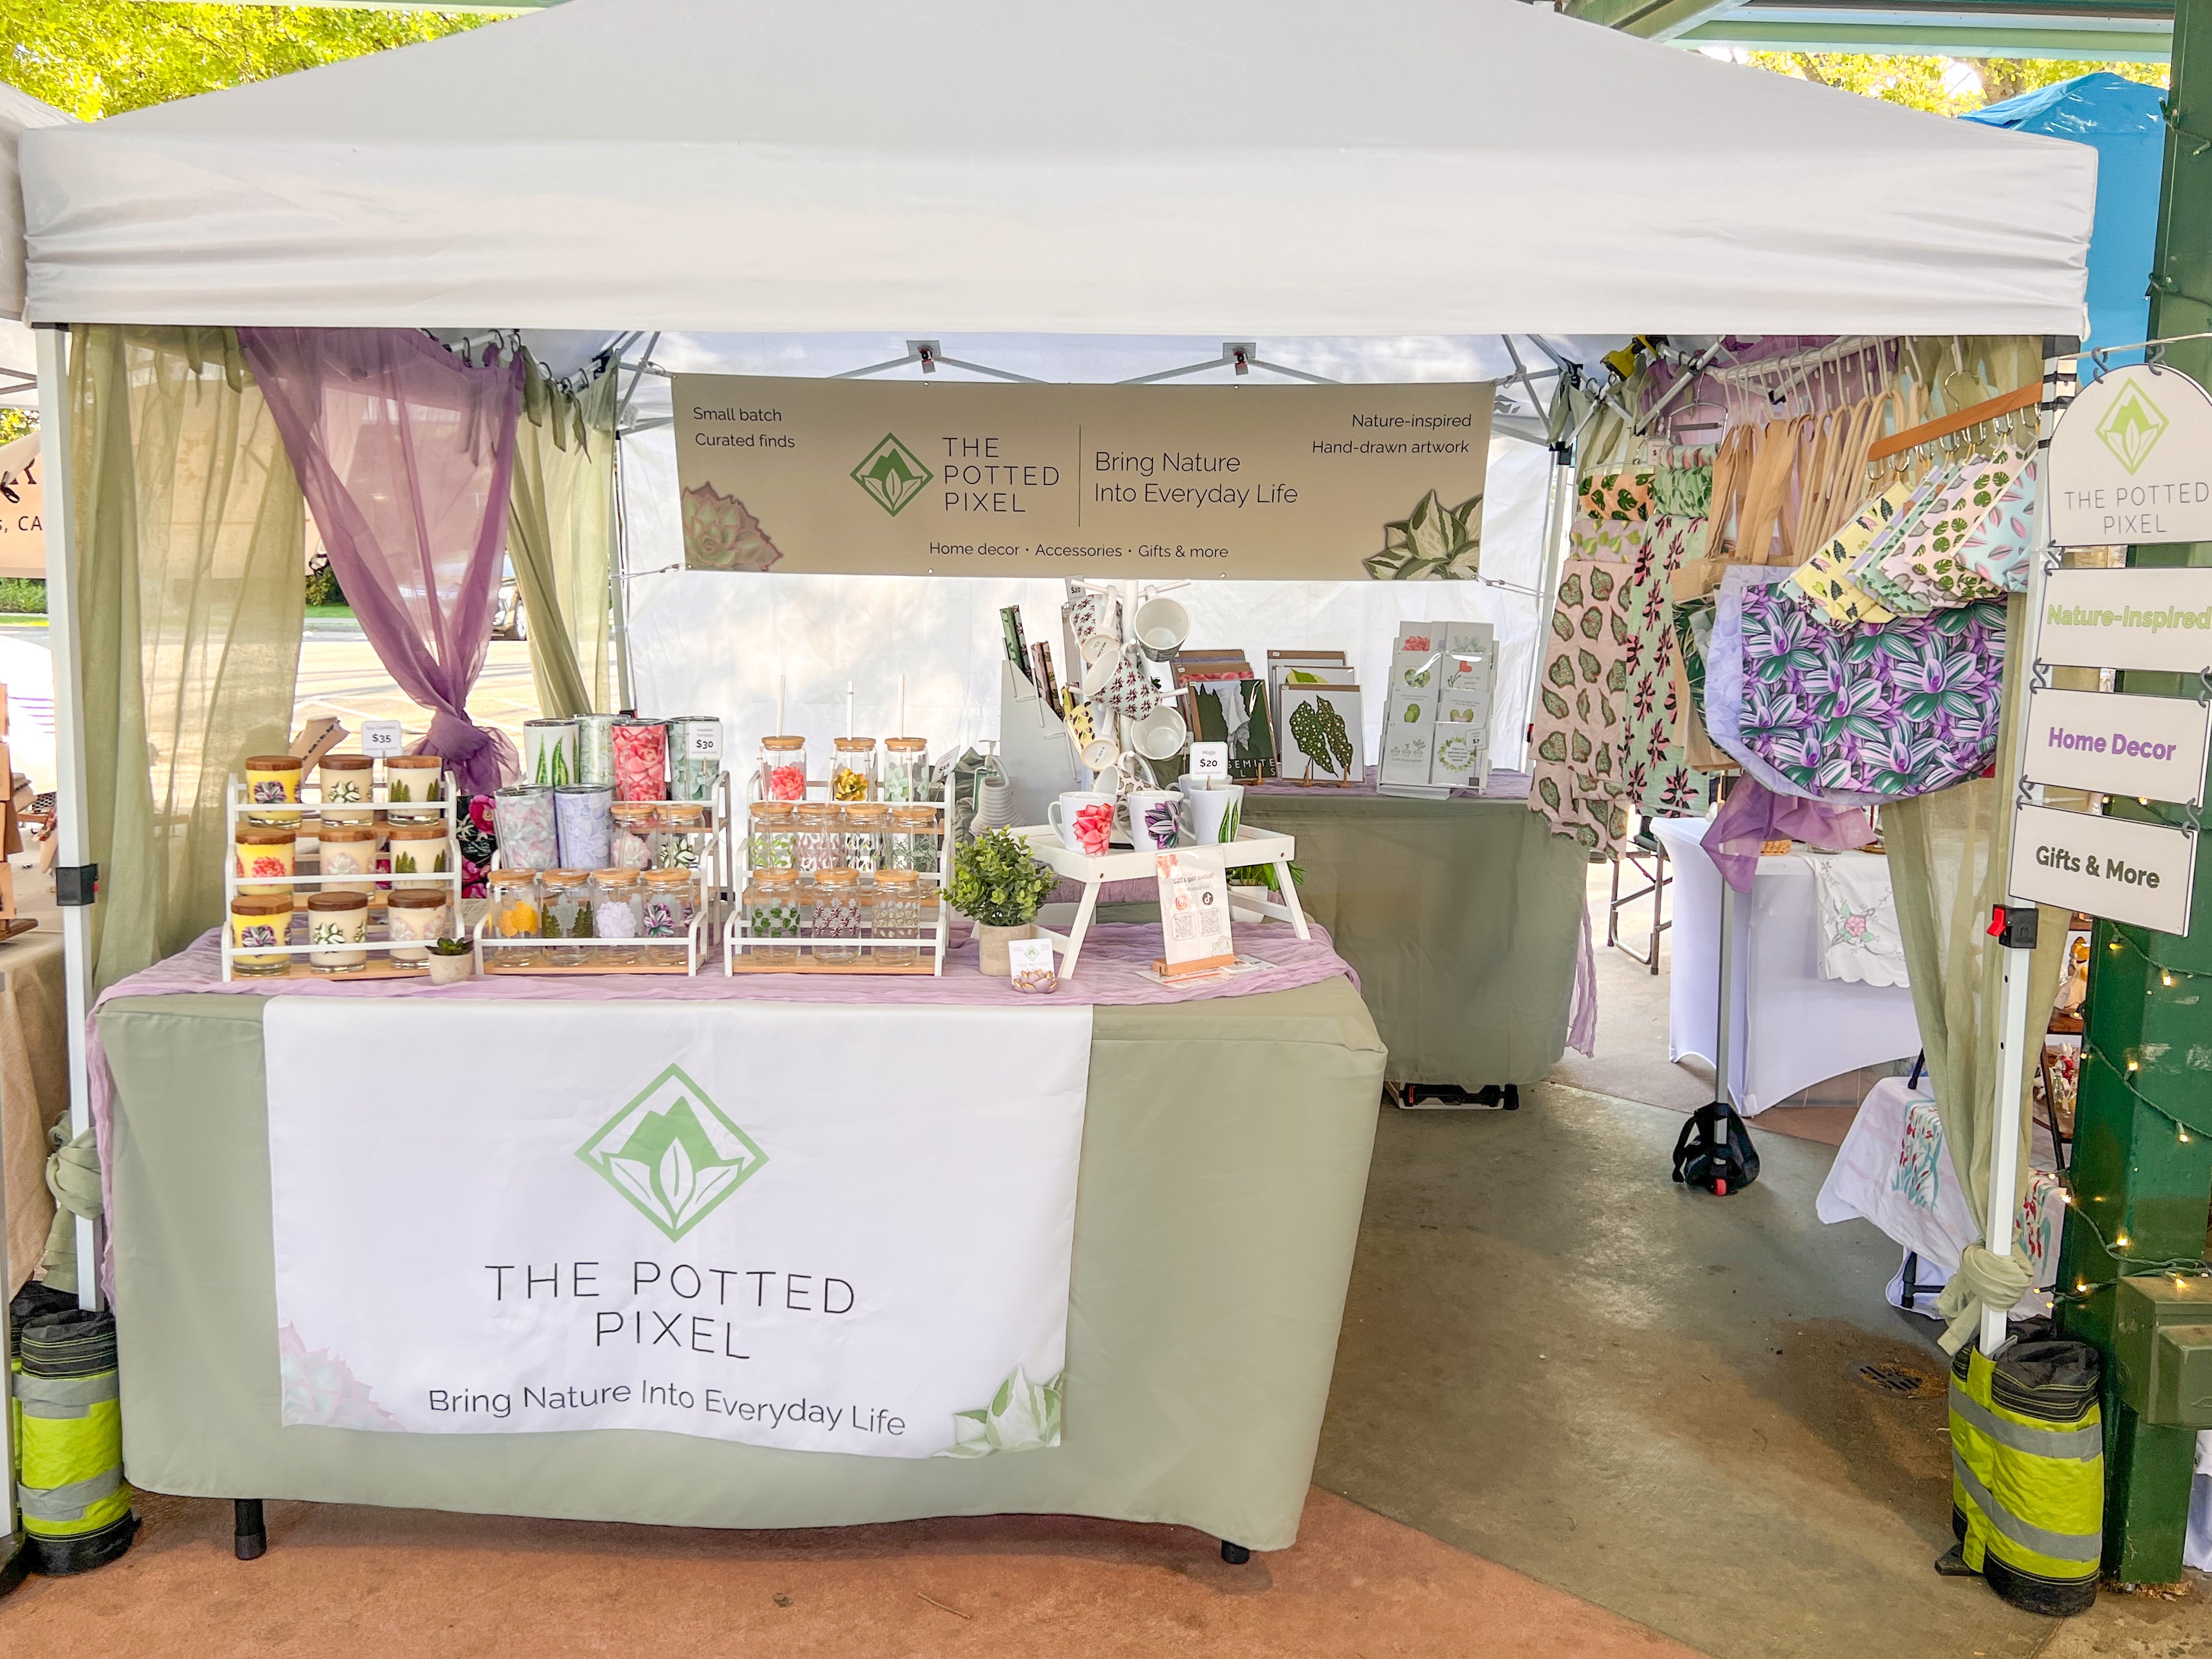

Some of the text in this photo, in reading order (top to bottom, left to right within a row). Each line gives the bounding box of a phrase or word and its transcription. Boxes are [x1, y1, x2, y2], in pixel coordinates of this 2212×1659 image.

[693, 407, 782, 422] Small batch
[1352, 414, 1471, 430] Nature-inspired
[696, 433, 795, 448] Curated finds
[942, 437, 998, 458] THE
[1313, 440, 1469, 453] Hand-drawn artwork
[1097, 451, 1241, 476] Bring Nature
[945, 465, 1059, 486] POTTED
[945, 492, 1025, 512] PIXEL
[1096, 483, 1298, 508] Into Everyday Life
[2065, 483, 2208, 509] THE POTTED
[2104, 514, 2166, 534] PIXEL
[930, 542, 1228, 558] Home decor Accessories Gifts & more
[2048, 604, 2211, 633] Nature-Inspired
[372, 734, 392, 743] $35
[696, 740, 713, 749] $30
[2049, 727, 2176, 760] Home Decor
[1200, 758, 1218, 768] $20
[1228, 758, 1275, 769] SEMITE
[2036, 846, 2160, 888] Gifts & More
[485, 1262, 854, 1315] THE POTTED
[597, 1311, 749, 1359] PIXEL
[430, 1380, 905, 1435] Bring Nature Into Everyday Life
